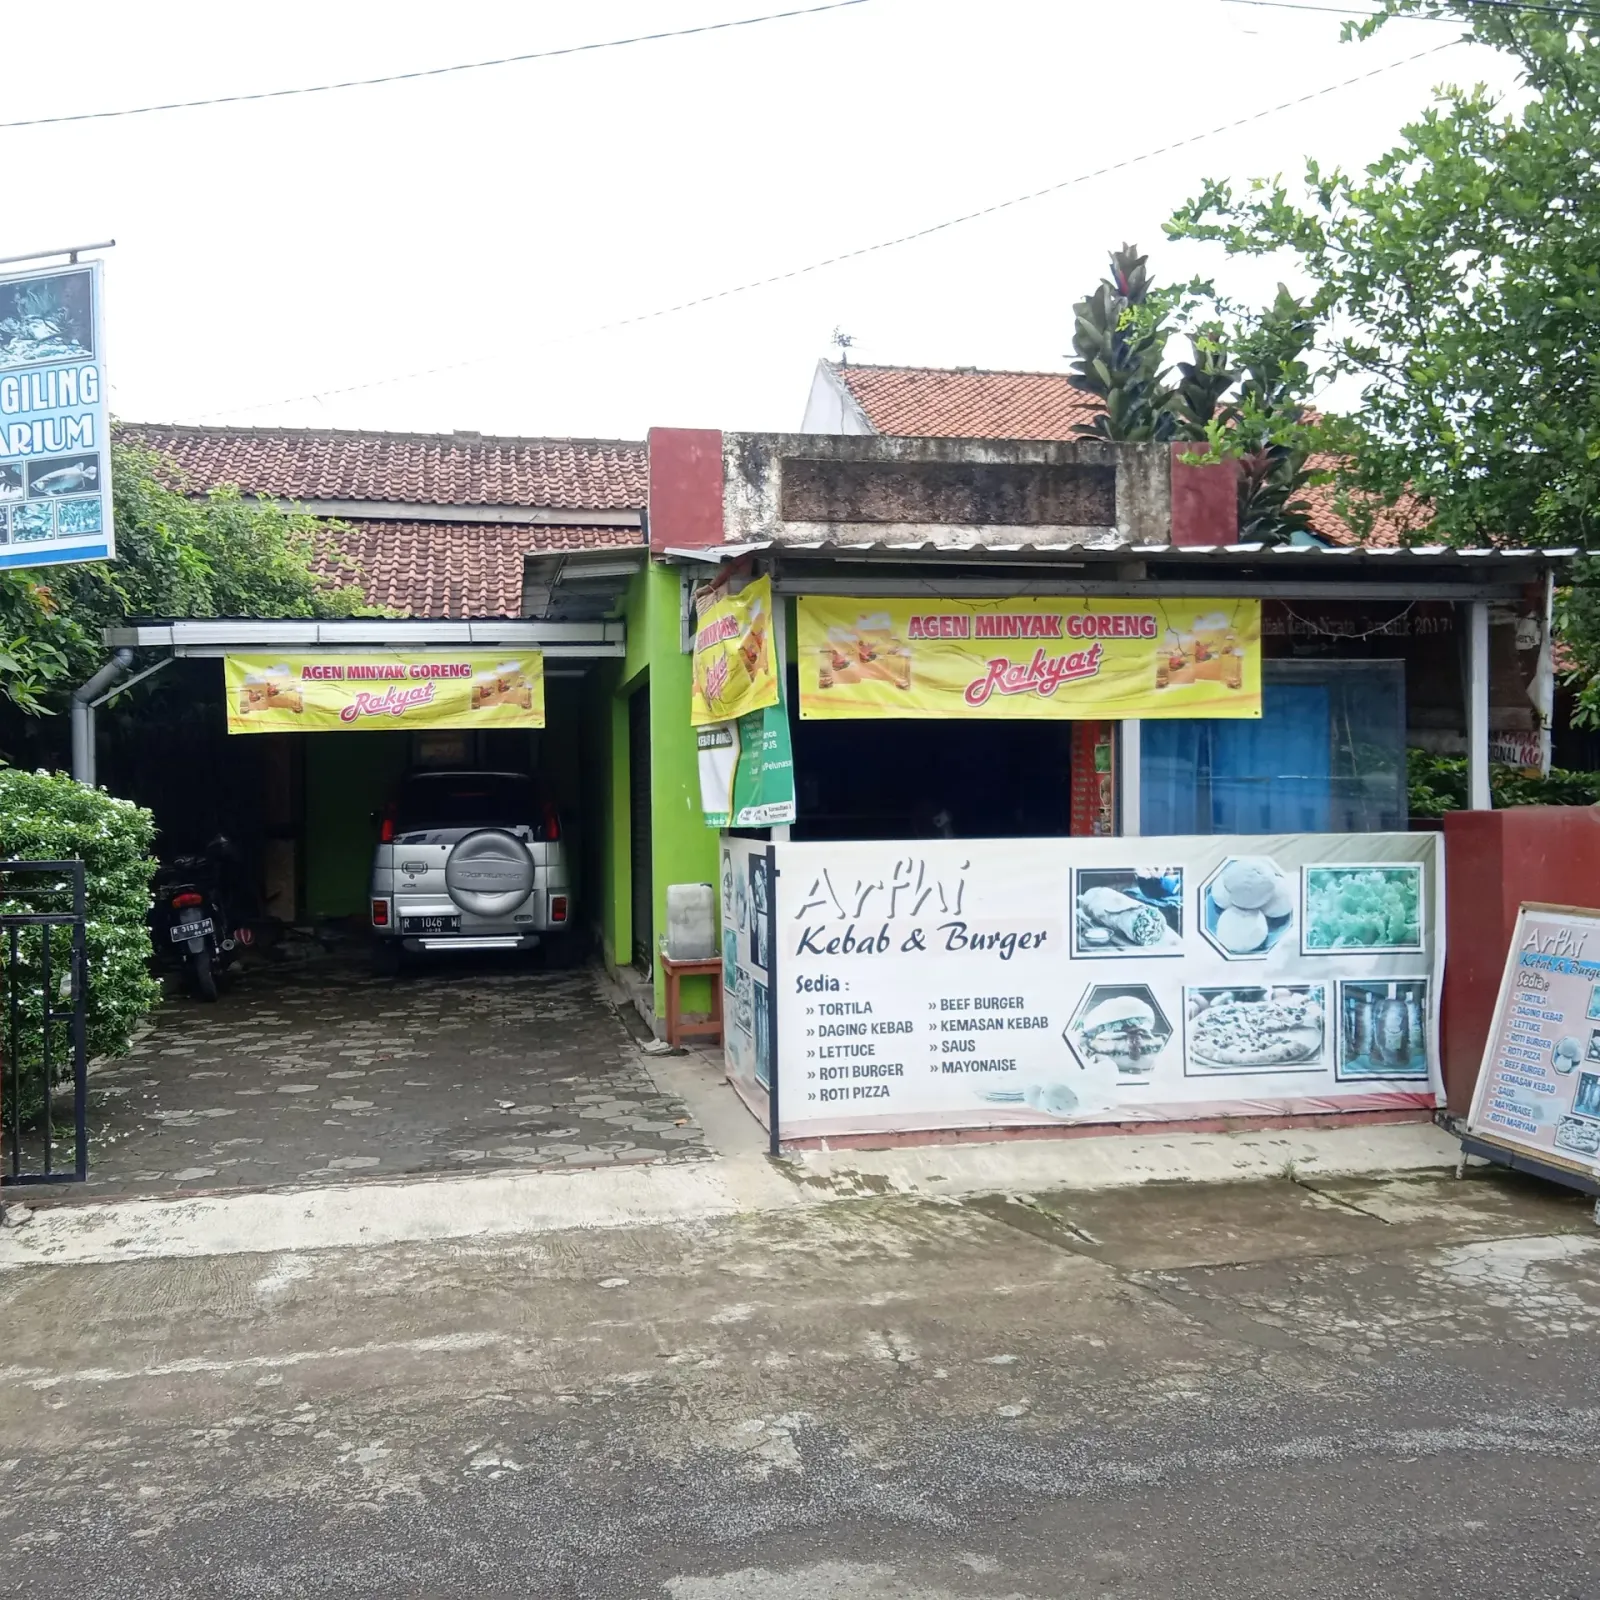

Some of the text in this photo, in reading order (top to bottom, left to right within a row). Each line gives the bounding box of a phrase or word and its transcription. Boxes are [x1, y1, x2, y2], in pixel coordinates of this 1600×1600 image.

[908, 615, 1156, 639] AGEN MINYAK GORENG
[301, 663, 472, 681] AGEN MINYAK GORENG
[964, 642, 1104, 708] Rakyat
[340, 682, 436, 723] Rakyat
[421, 916, 443, 928] 1046
[795, 921, 1047, 960] Kebab & Burger
[1522, 927, 1588, 958] Arfhi
[1522, 953, 1552, 971] Kebab
[1554, 960, 1564, 972] &
[940, 996, 1025, 1011] BEEF BURGER
[1521, 993, 1546, 1004] TORTILA
[818, 1001, 873, 1016] TORTILA
[1517, 1006, 1564, 1022] DAGING KEBAB
[818, 1020, 914, 1038] DAGING KEBAB
[940, 1016, 1049, 1032] KEMASAN KEBAB
[1513, 1019, 1541, 1032] LETTUCE
[941, 1039, 976, 1053] SAUS
[1510, 1032, 1552, 1049] ROTI BURGER
[819, 1043, 876, 1059] LETTUCE
[1507, 1046, 1541, 1061] ROTI PIZZA
[819, 1063, 904, 1080] ROTI BURGER
[941, 1058, 1017, 1073] MAYONAISE
[1504, 1060, 1546, 1077] BEEF BURGER
[1498, 1086, 1515, 1097] SAUS
[1501, 1073, 1556, 1094] KEMASAN KEBAB
[820, 1085, 890, 1101] ROTI PIZZA
[1494, 1099, 1532, 1116] MAYONAISE
[1491, 1113, 1537, 1133] ROTI MARYAM
